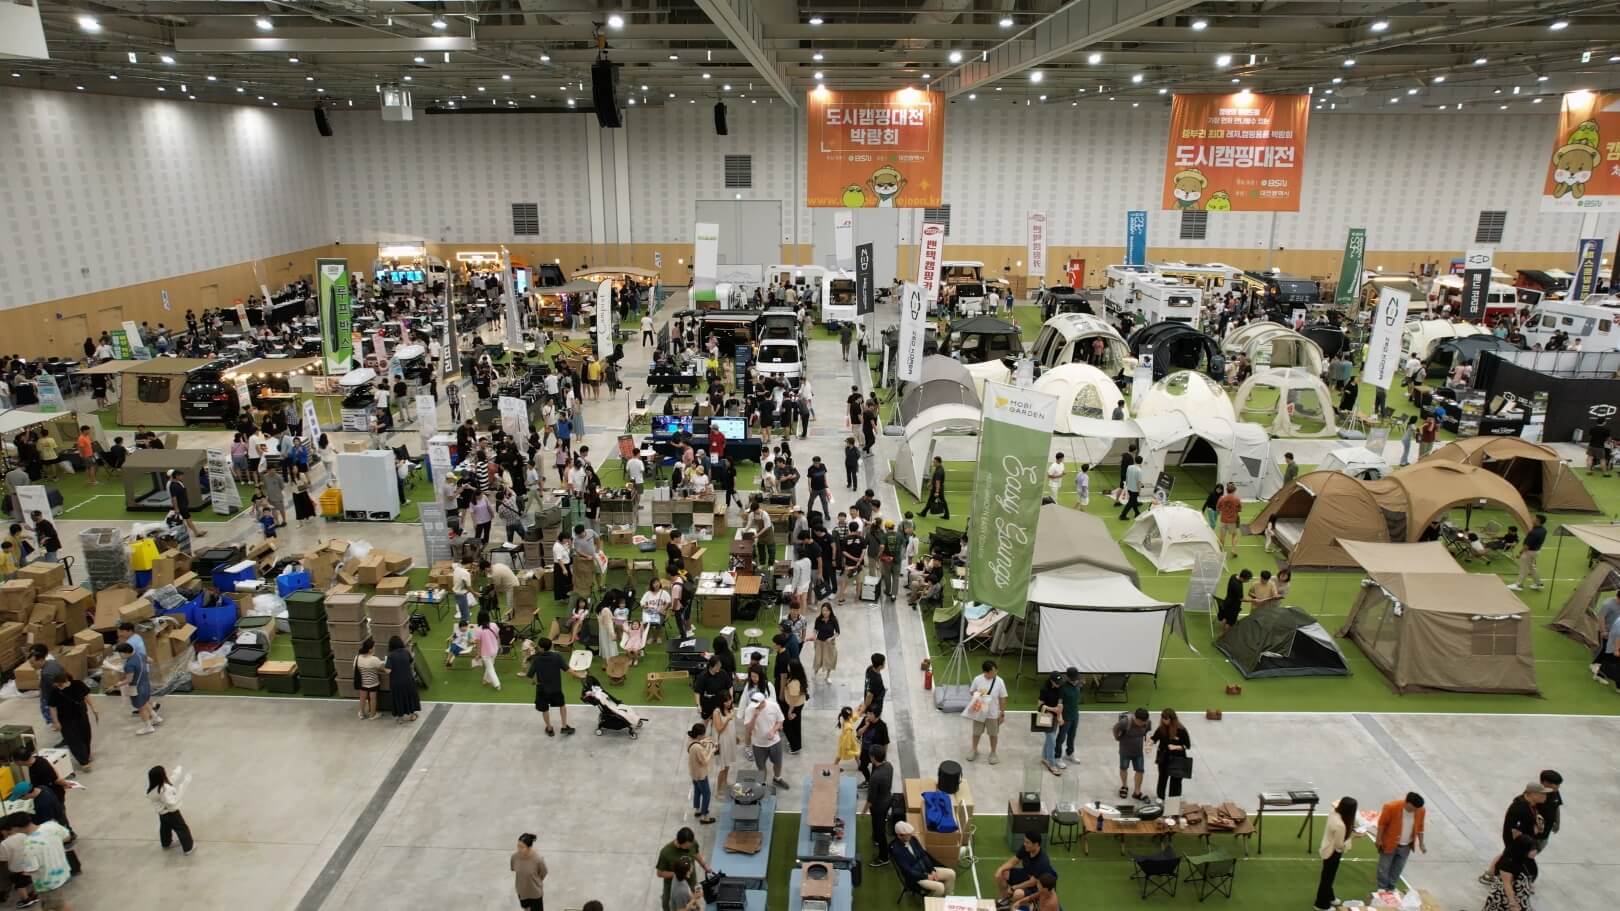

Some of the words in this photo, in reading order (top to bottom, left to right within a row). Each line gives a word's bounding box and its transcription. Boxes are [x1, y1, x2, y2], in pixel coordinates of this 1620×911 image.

[826, 108, 924, 126] 도시캠핑대전
[850, 128, 899, 145] 박람회
[1174, 145, 1295, 168] 도시캠핑대전
[337, 285, 351, 349] 루프박스
[1008, 407, 1045, 419] GARDEN
[1010, 400, 1032, 409] MOBI
[995, 454, 1038, 514] Easy
[988, 517, 1028, 589] Goings
